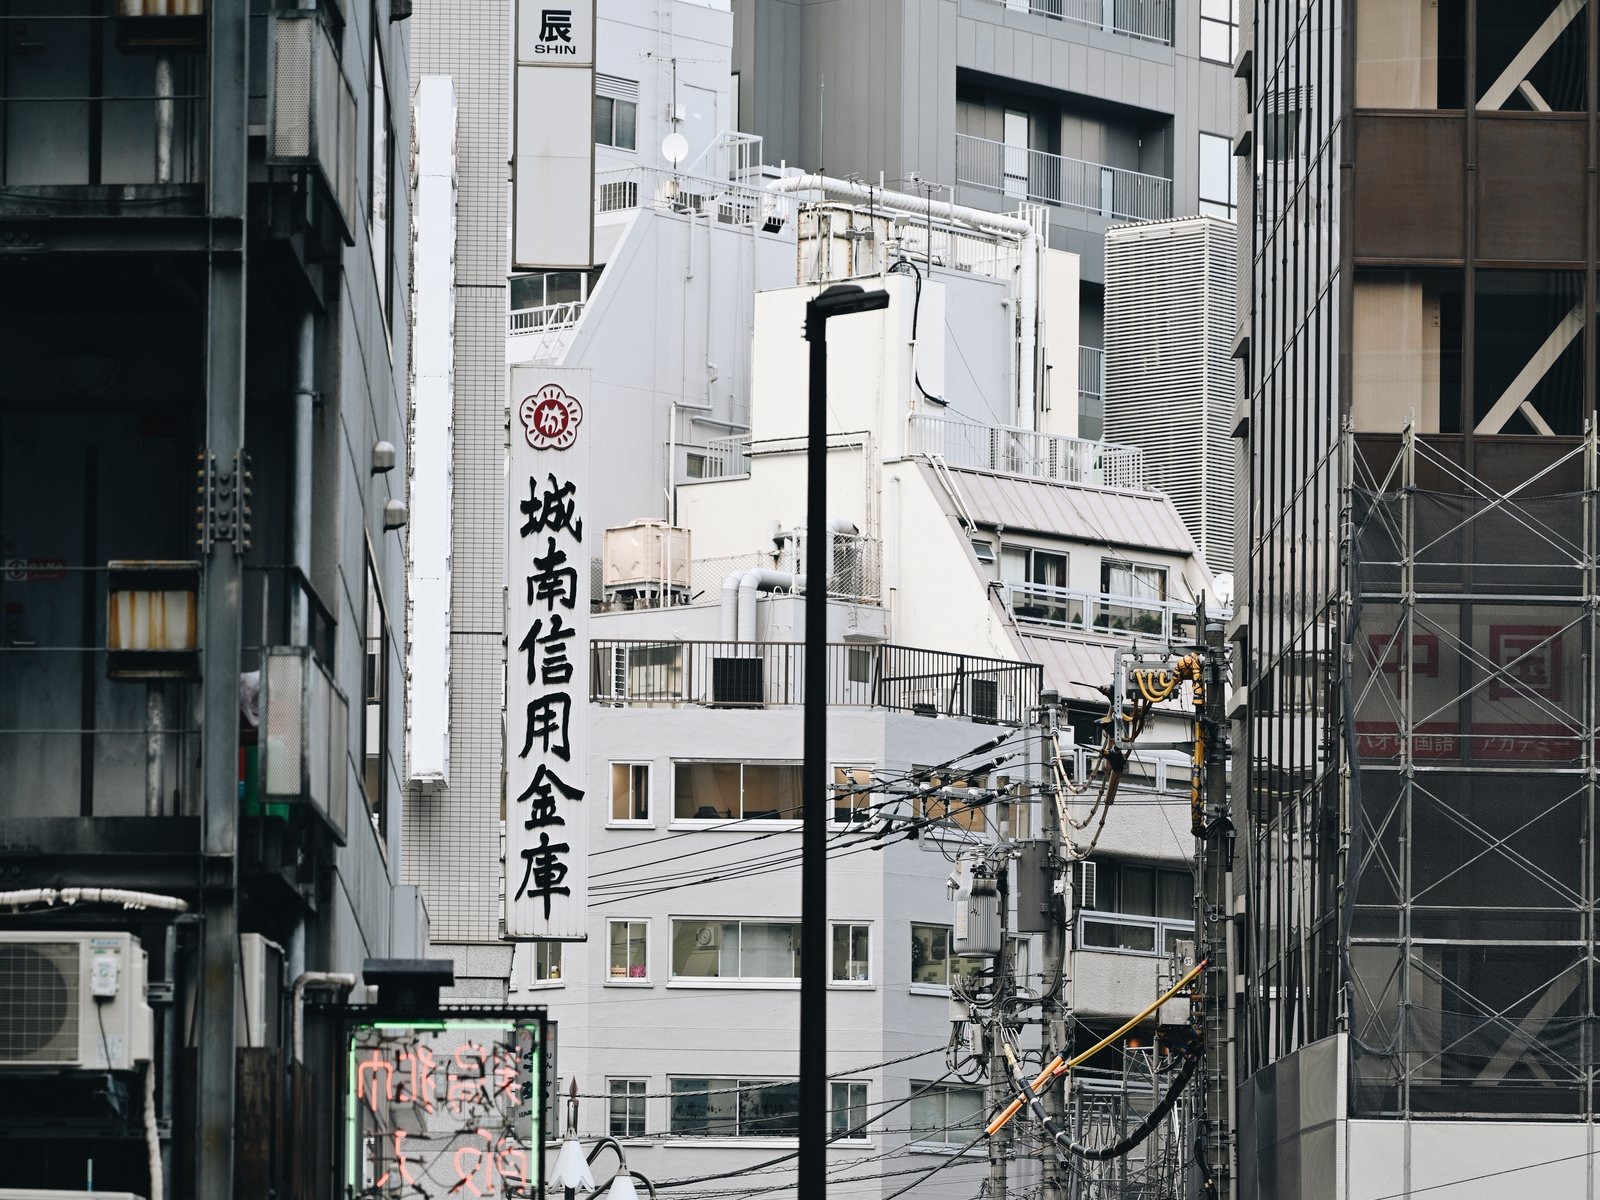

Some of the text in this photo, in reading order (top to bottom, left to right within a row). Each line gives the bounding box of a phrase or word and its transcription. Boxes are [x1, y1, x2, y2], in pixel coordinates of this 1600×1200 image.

[539, 9, 571, 42] 辰
[534, 44, 576, 54] SHIN
[514, 473, 585, 920] 城南信用金庫
